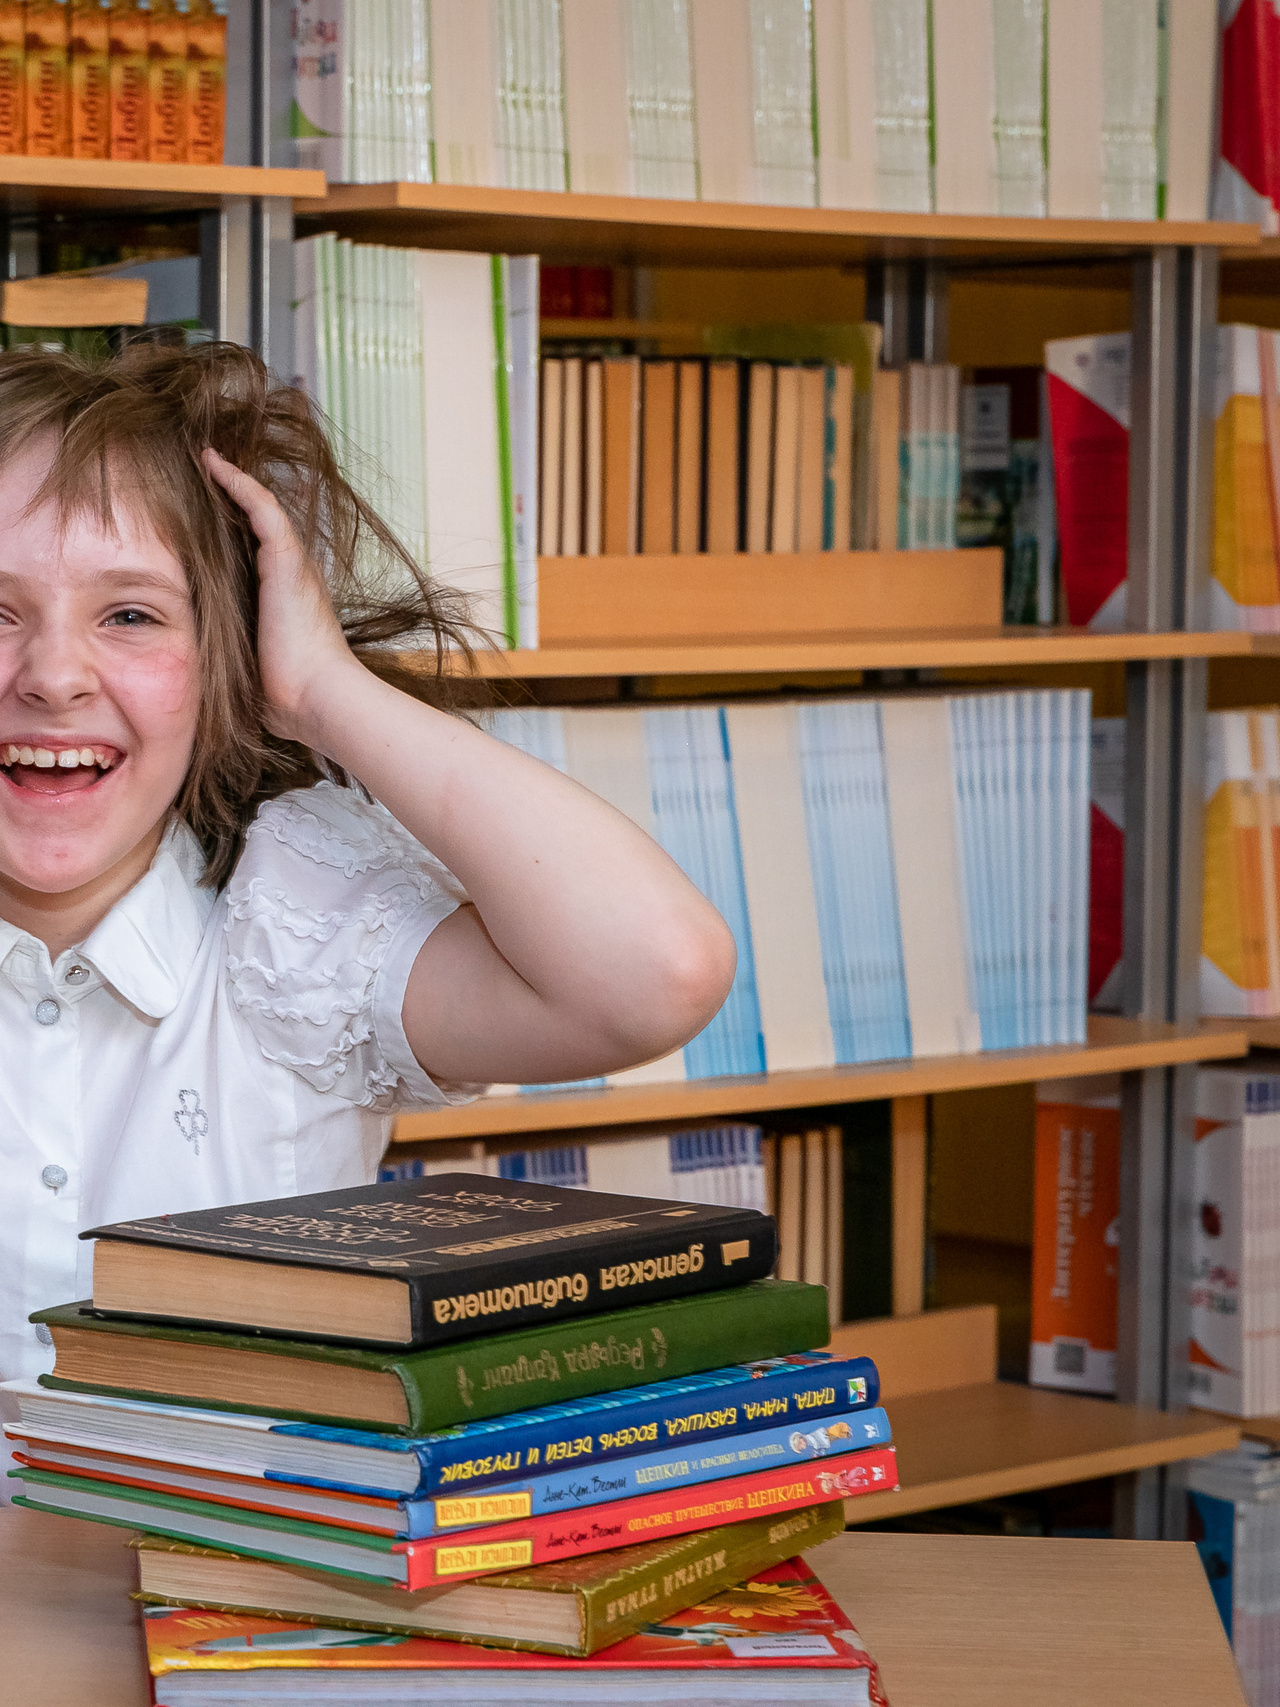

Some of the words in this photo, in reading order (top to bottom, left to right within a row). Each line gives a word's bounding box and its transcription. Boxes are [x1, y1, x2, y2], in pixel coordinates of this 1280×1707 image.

[600, 1243, 704, 1290] детская
[434, 1275, 587, 1324] библиотека
[483, 1349, 560, 1391] Киплинг
[564, 1335, 644, 1373] Редьярд
[664, 1405, 736, 1435] БАБУШКА,
[744, 1396, 788, 1420] МАМА,
[545, 1438, 592, 1464] ДЕТЕЙ
[599, 1424, 657, 1450] ВОСЕМЬ
[440, 1453, 520, 1483] ГРУЗОВИК
[528, 1447, 540, 1463] И
[635, 1460, 690, 1484] ЩЕПКИН
[628, 1513, 672, 1532] ОПАСНОЕ
[675, 1498, 743, 1521] ПУТЕШЕСТВИЕ
[746, 1482, 815, 1510] ЩЕПКИНА
[664, 1550, 726, 1596] ЖЕЛТЫЙ
[606, 1582, 657, 1623] ТУМАН
